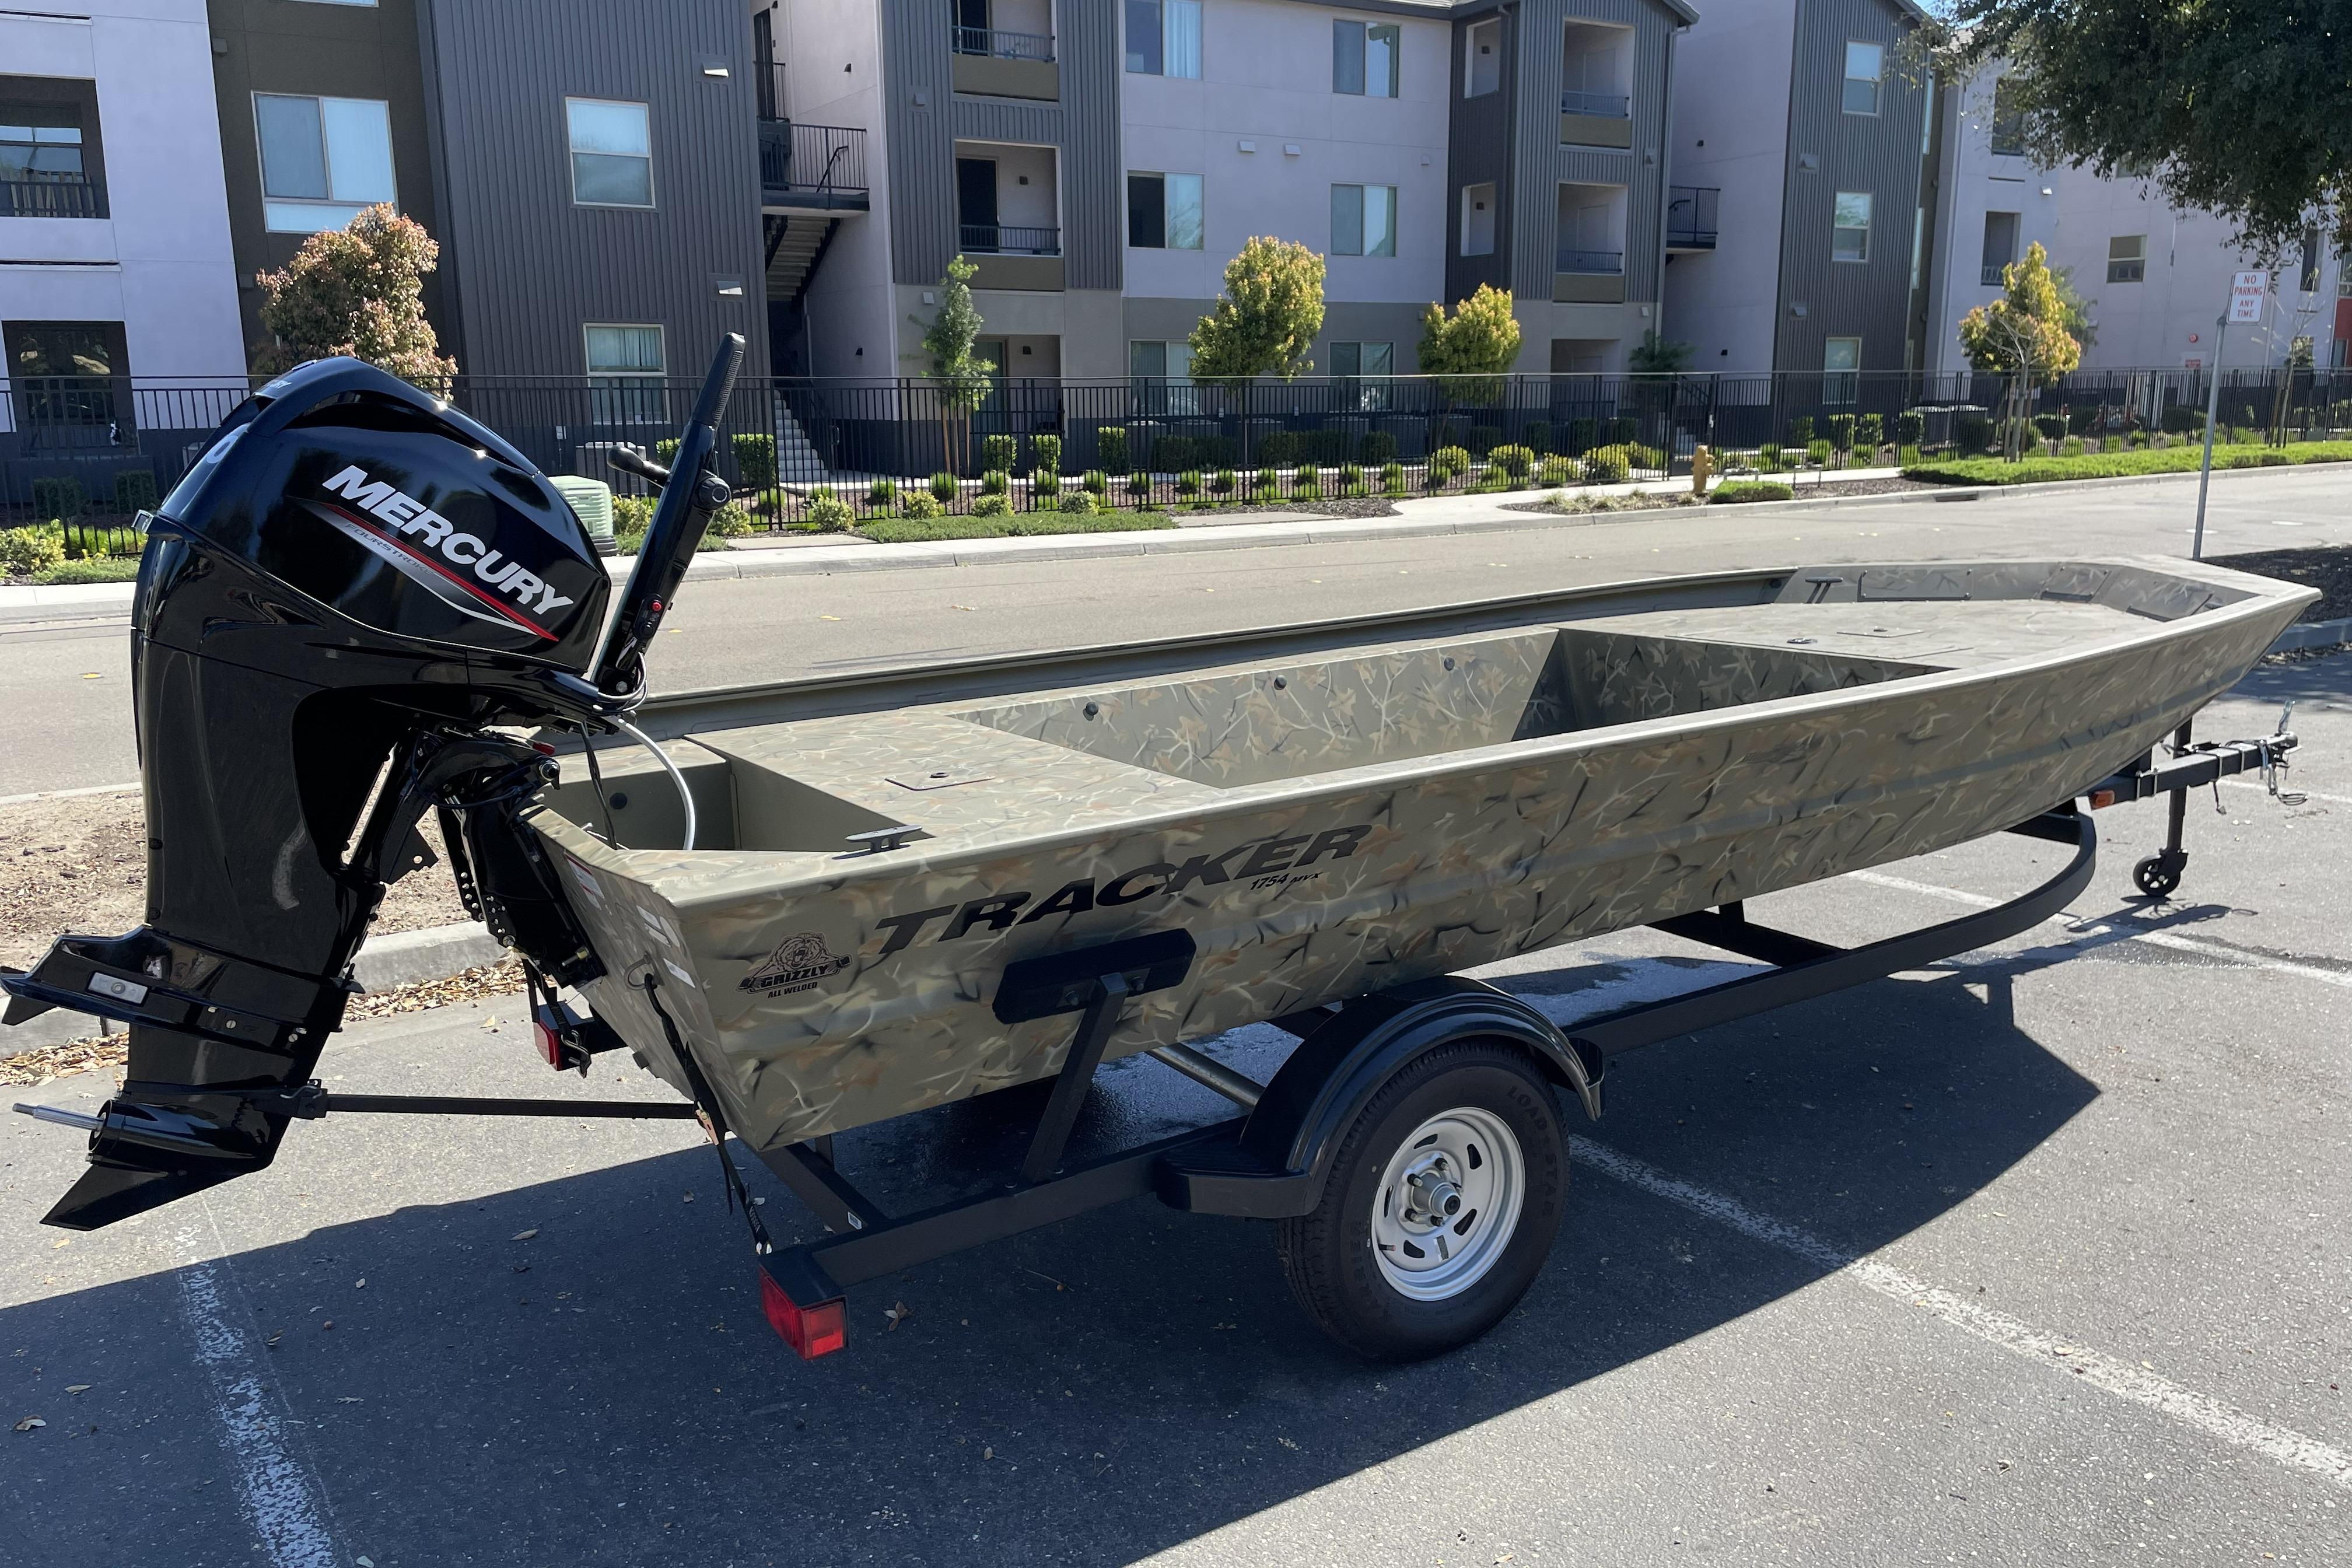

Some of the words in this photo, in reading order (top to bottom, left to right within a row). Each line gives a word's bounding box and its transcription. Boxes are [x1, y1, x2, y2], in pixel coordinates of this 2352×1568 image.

[2244, 275, 2256, 285] NO
[2234, 286, 2263, 296] PARKING
[2239, 299, 2255, 307] ANY
[2238, 309, 2254, 318] TIME
[322, 465, 573, 615] MERCURY
[345, 523, 433, 575] FOURSTROKE
[874, 824, 1373, 955] TRACKER
[1250, 873, 1290, 891] 1754
[1290, 872, 1324, 884] MVX
[761, 964, 828, 988] GRIZZLY
[767, 989, 781, 999] ALL
[784, 981, 818, 995] WELDED
[1506, 1085, 1548, 1130] LOAD
